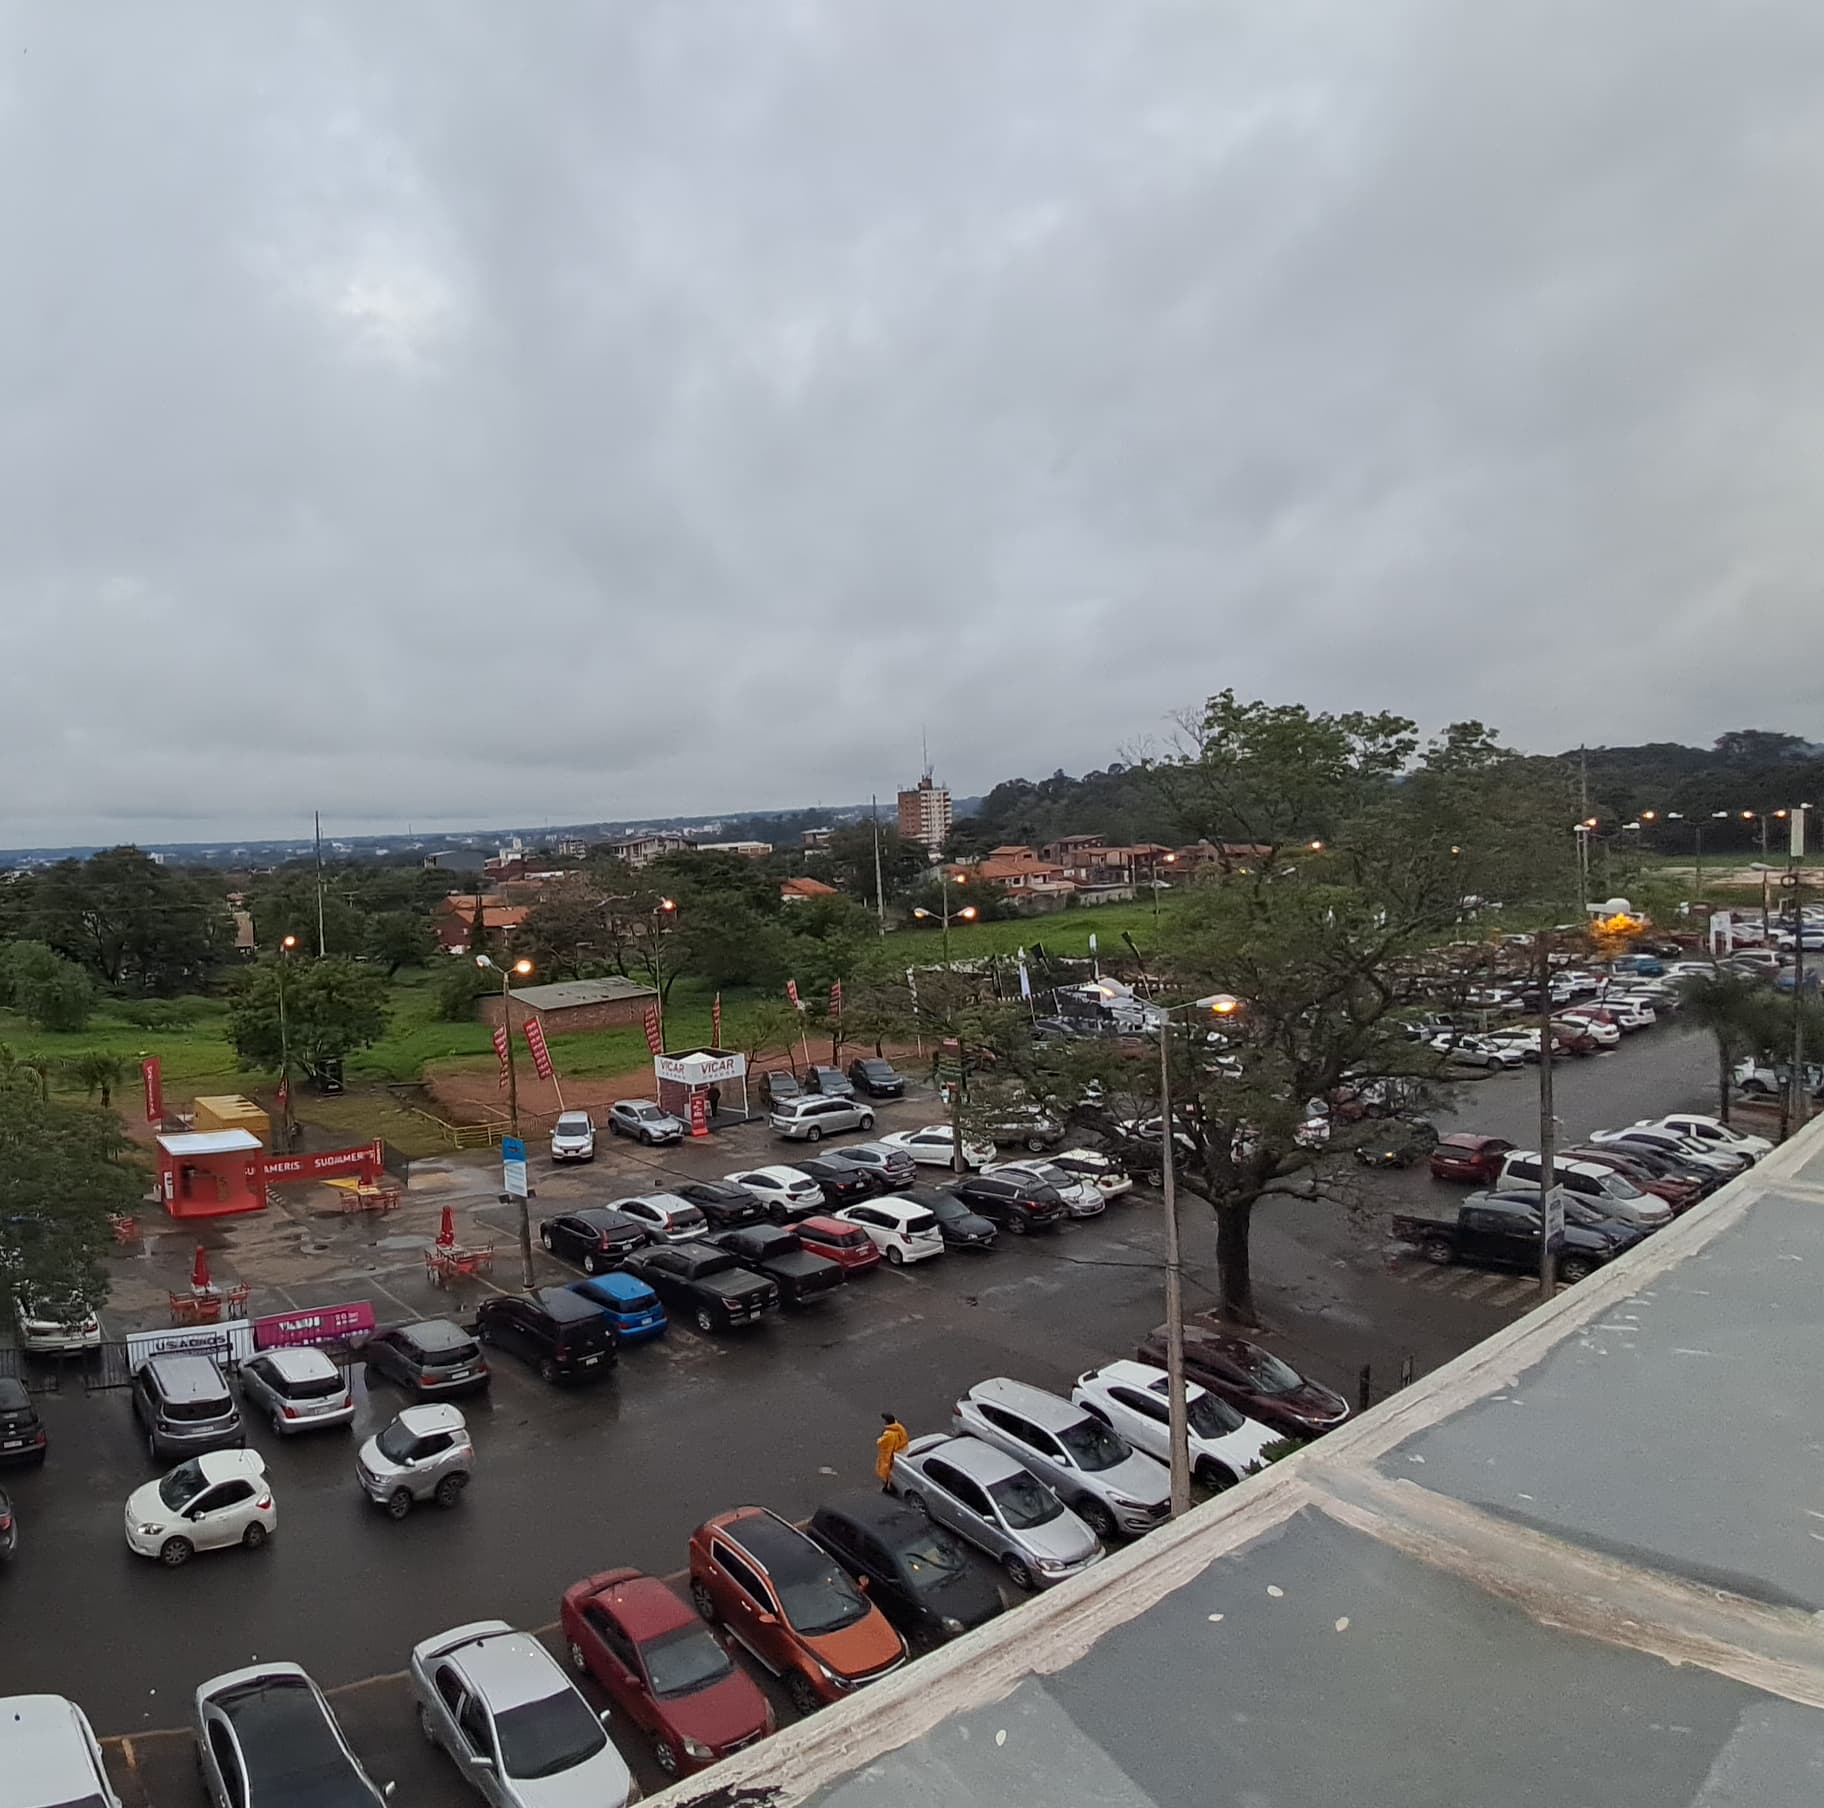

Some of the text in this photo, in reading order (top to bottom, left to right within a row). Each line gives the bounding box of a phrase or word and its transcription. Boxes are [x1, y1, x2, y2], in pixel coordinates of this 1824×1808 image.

[660, 1059, 685, 1073] VICAR
[701, 1058, 735, 1074] VICAR
[314, 1149, 375, 1168] SUDAMERS
